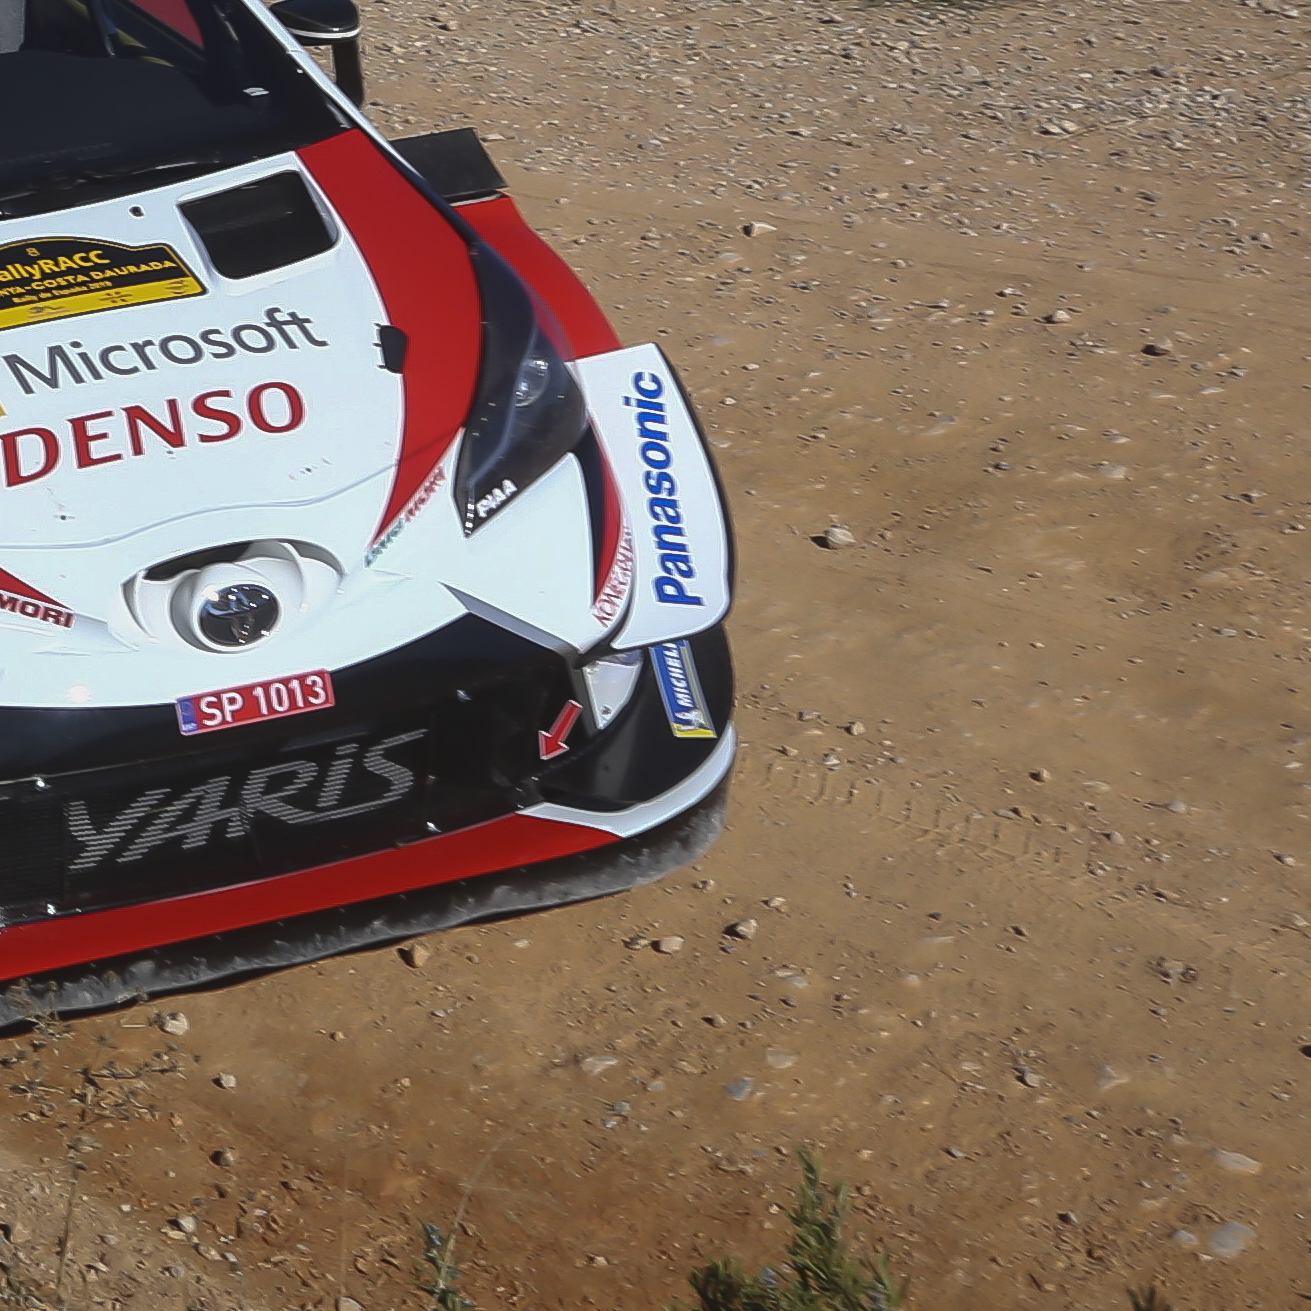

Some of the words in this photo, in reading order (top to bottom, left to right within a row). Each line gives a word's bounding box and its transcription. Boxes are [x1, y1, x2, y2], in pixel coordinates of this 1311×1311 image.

[1, 305, 329, 396] Microsoft
[621, 370, 707, 609] Panasonic
[198, 691, 245, 727] SP
[252, 674, 328, 716] 1013
[661, 640, 695, 708] MICHELI
